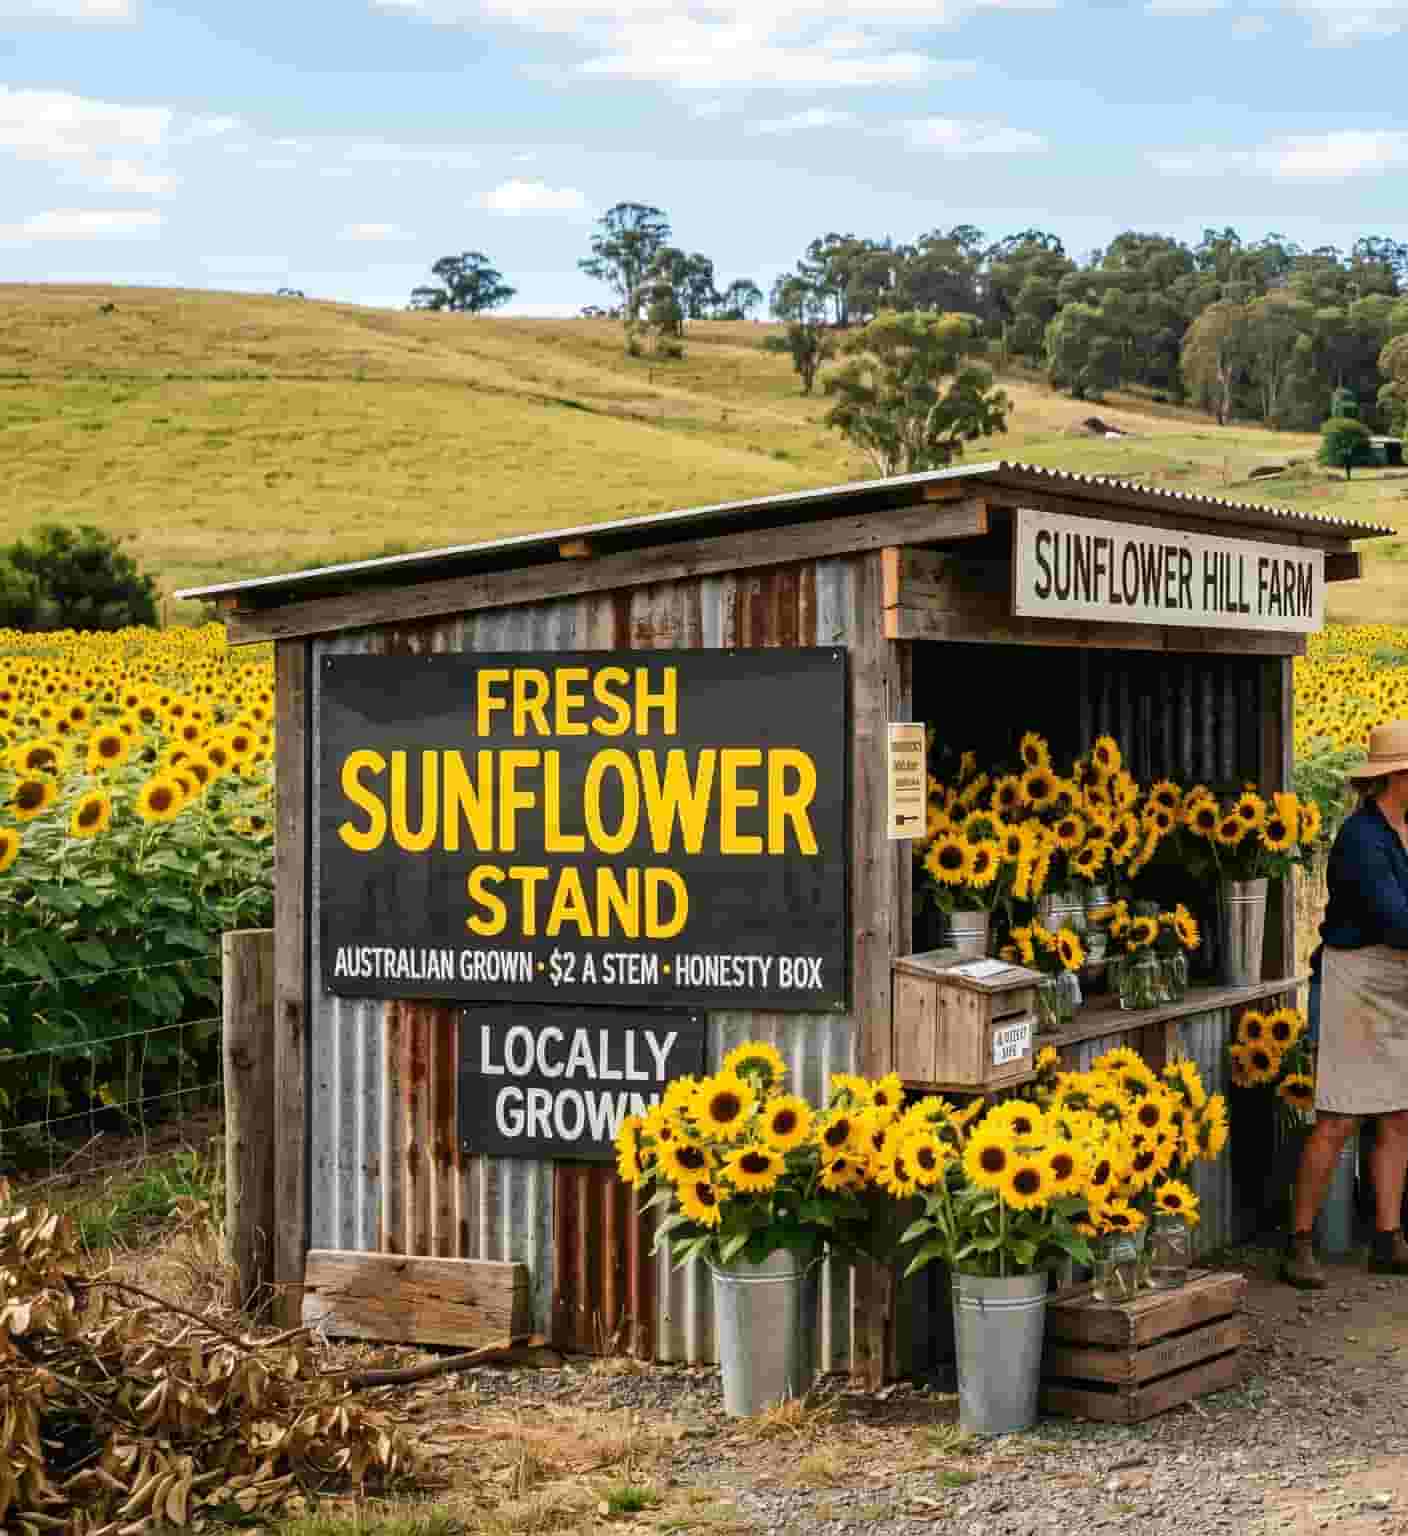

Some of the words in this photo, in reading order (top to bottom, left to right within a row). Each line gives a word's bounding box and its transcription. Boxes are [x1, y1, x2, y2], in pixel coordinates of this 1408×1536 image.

[1033, 529, 1193, 610] SUNFLOWER
[1201, 549, 1251, 614] HILL
[1257, 556, 1314, 617] FARM
[476, 666, 679, 737] FRESH
[337, 748, 820, 856] SUNFLOWER
[465, 864, 690, 939] STAND
[333, 945, 454, 980] AUSTRALIAN
[459, 949, 534, 983] GROWN
[549, 946, 577, 987] $2
[581, 952, 597, 984] A
[601, 952, 659, 985] STEM
[674, 953, 773, 989] HONESTY
[777, 955, 824, 990] BOX
[480, 1024, 679, 1082] LOCALLY
